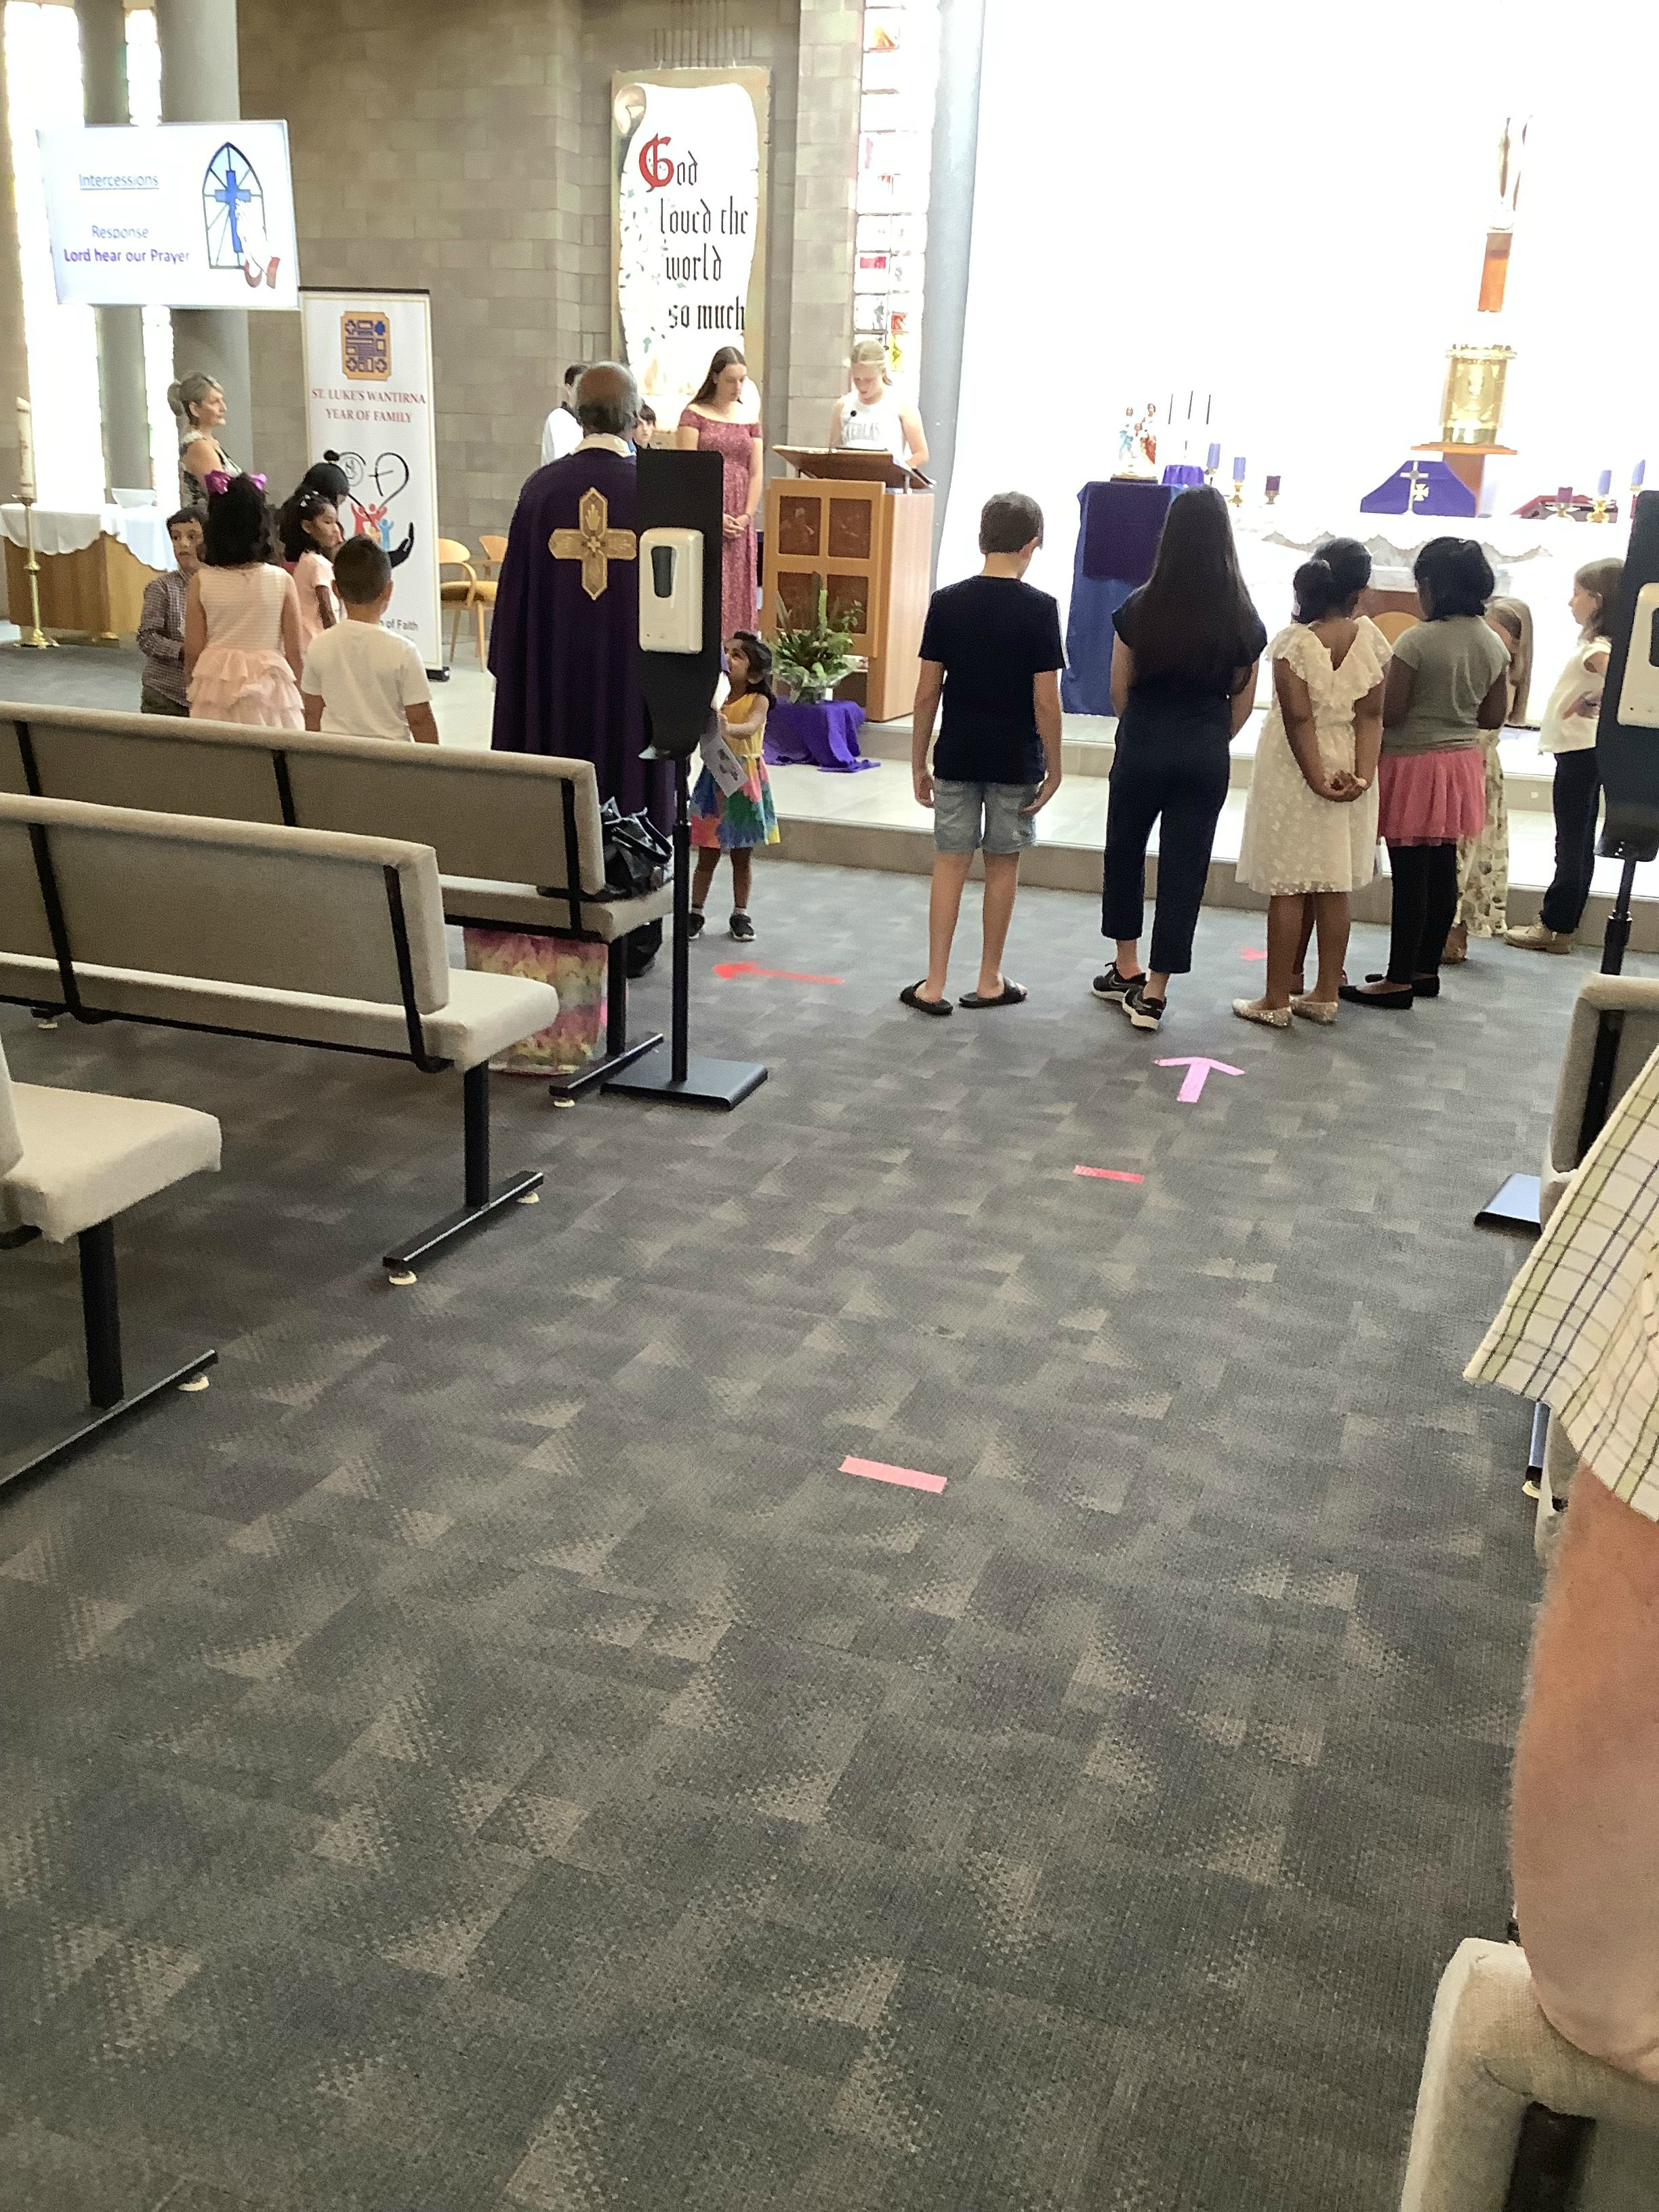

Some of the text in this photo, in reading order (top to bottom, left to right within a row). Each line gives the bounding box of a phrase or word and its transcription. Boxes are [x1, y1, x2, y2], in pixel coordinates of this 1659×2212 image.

[639, 133, 698, 192] God
[79, 174, 159, 189] Intercessions
[660, 195, 748, 234] loved the
[91, 225, 149, 240] Response
[64, 248, 189, 264] Lord hear our Prayer
[666, 243, 722, 281] world
[669, 295, 745, 330] so much
[329, 390, 364, 401] LUKE'S
[367, 392, 426, 404] WANTIRNA
[326, 409, 411, 423] YEAR OF FAMILY
[386, 619, 395, 628] of
[396, 619, 419, 630] Faith
